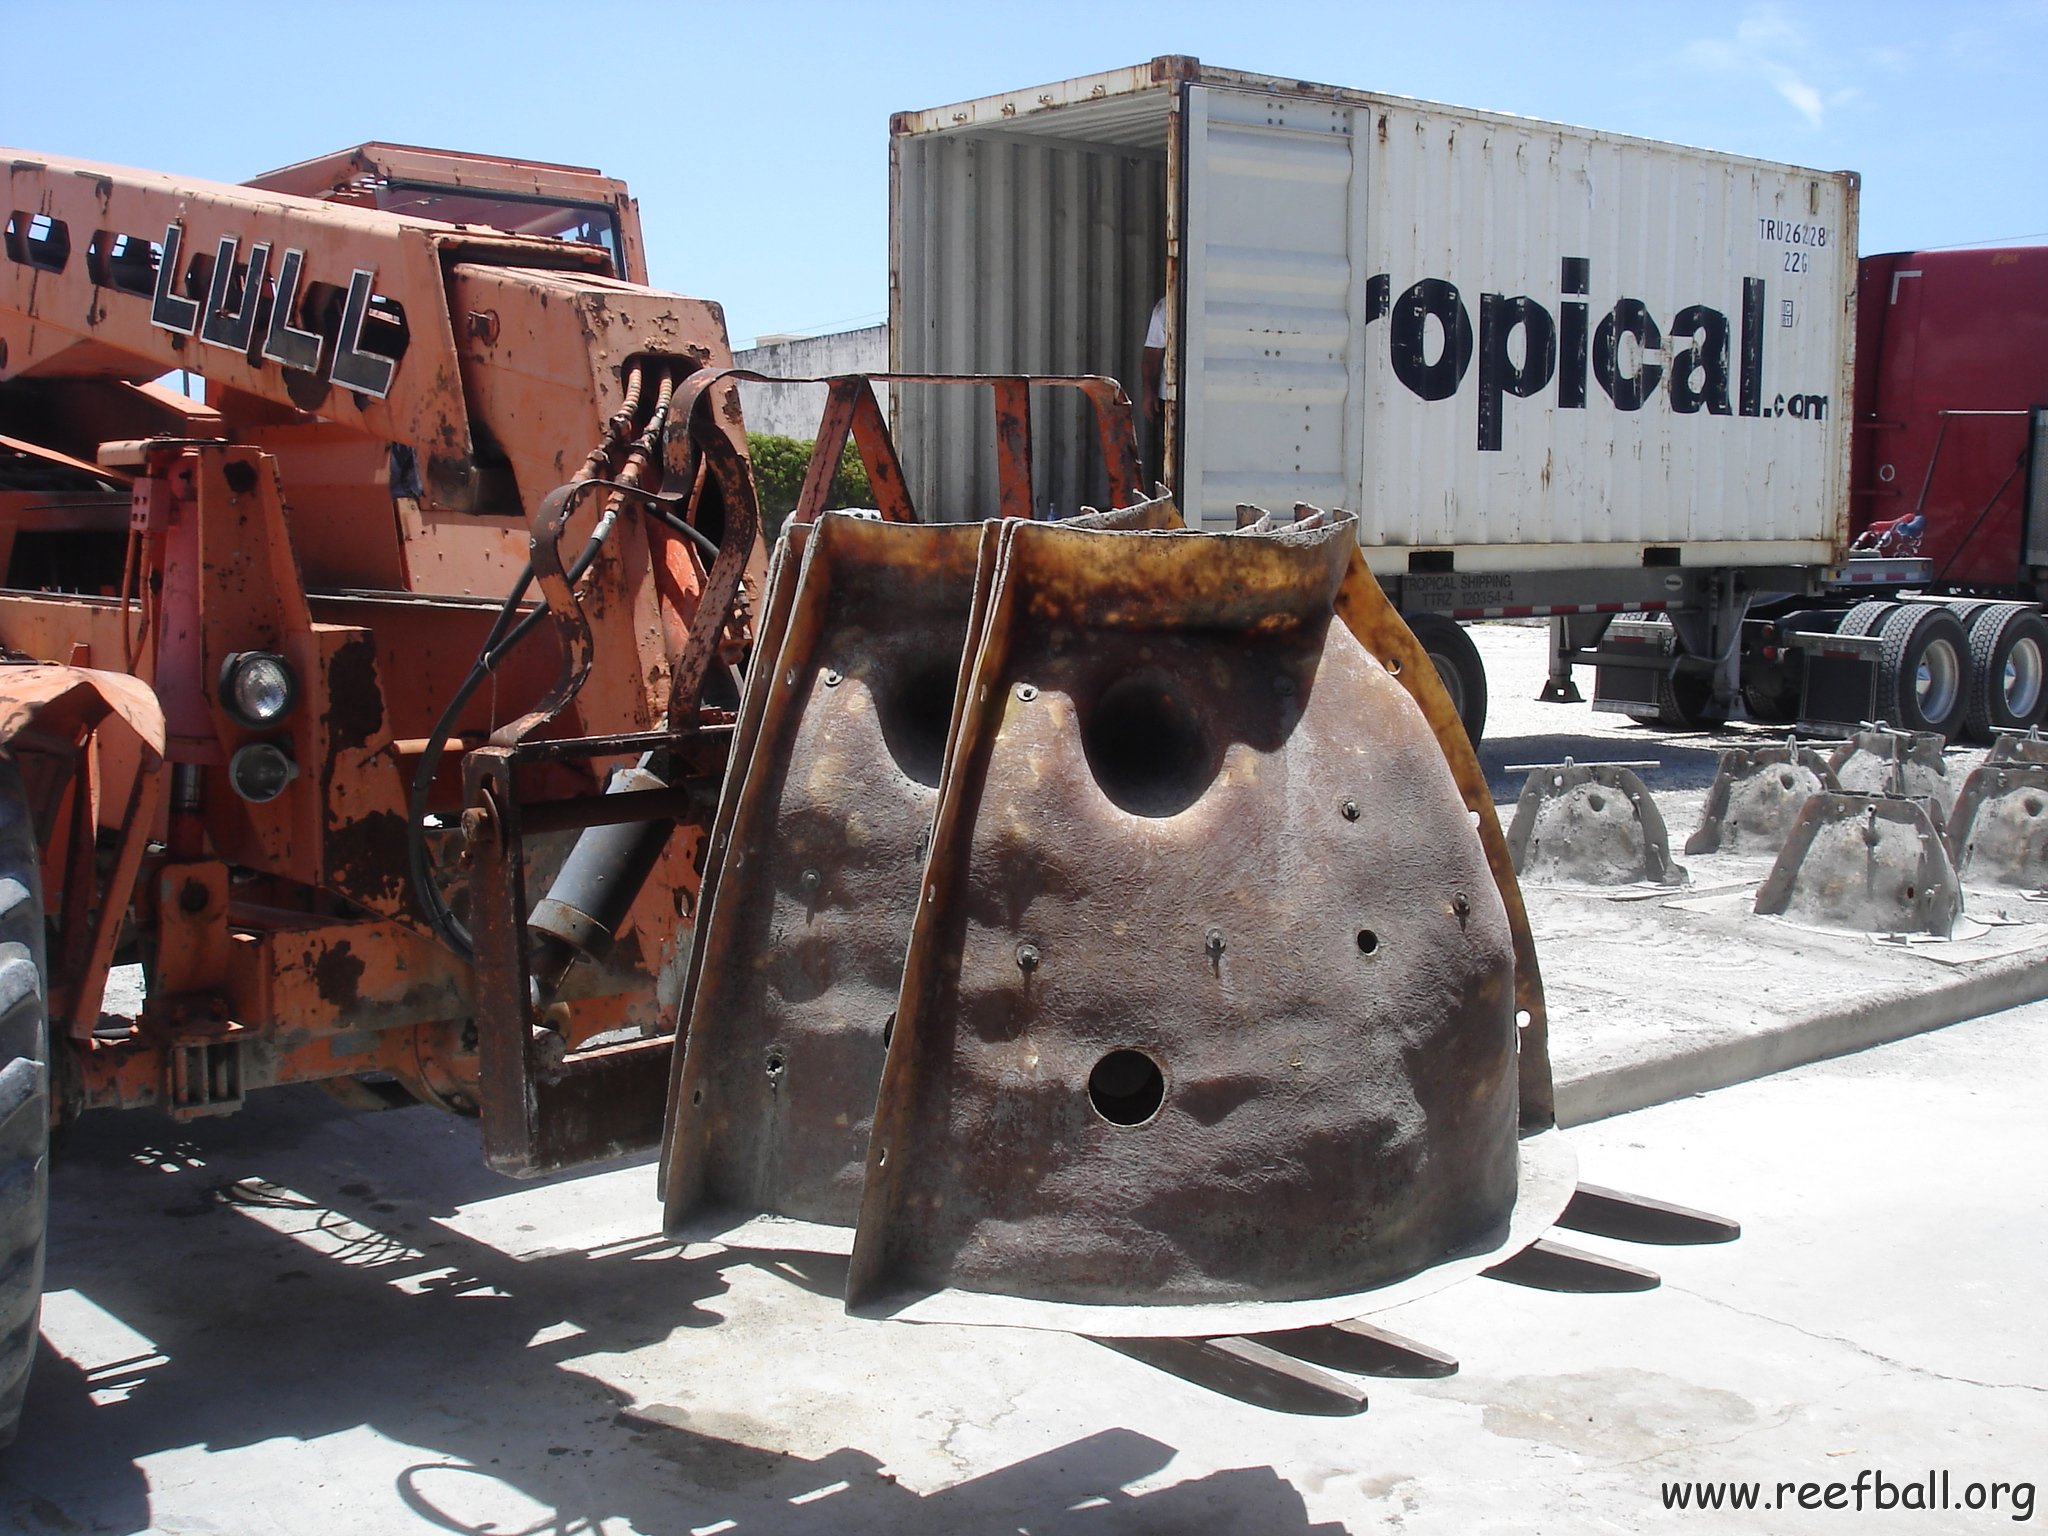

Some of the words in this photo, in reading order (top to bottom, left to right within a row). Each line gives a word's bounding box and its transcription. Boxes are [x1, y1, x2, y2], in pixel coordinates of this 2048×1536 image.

[151, 223, 397, 400] LULL
[1403, 576, 1456, 591] TROPICAL
[1460, 574, 1511, 589] SHIPPING
[1422, 593, 1452, 607] TTRZ
